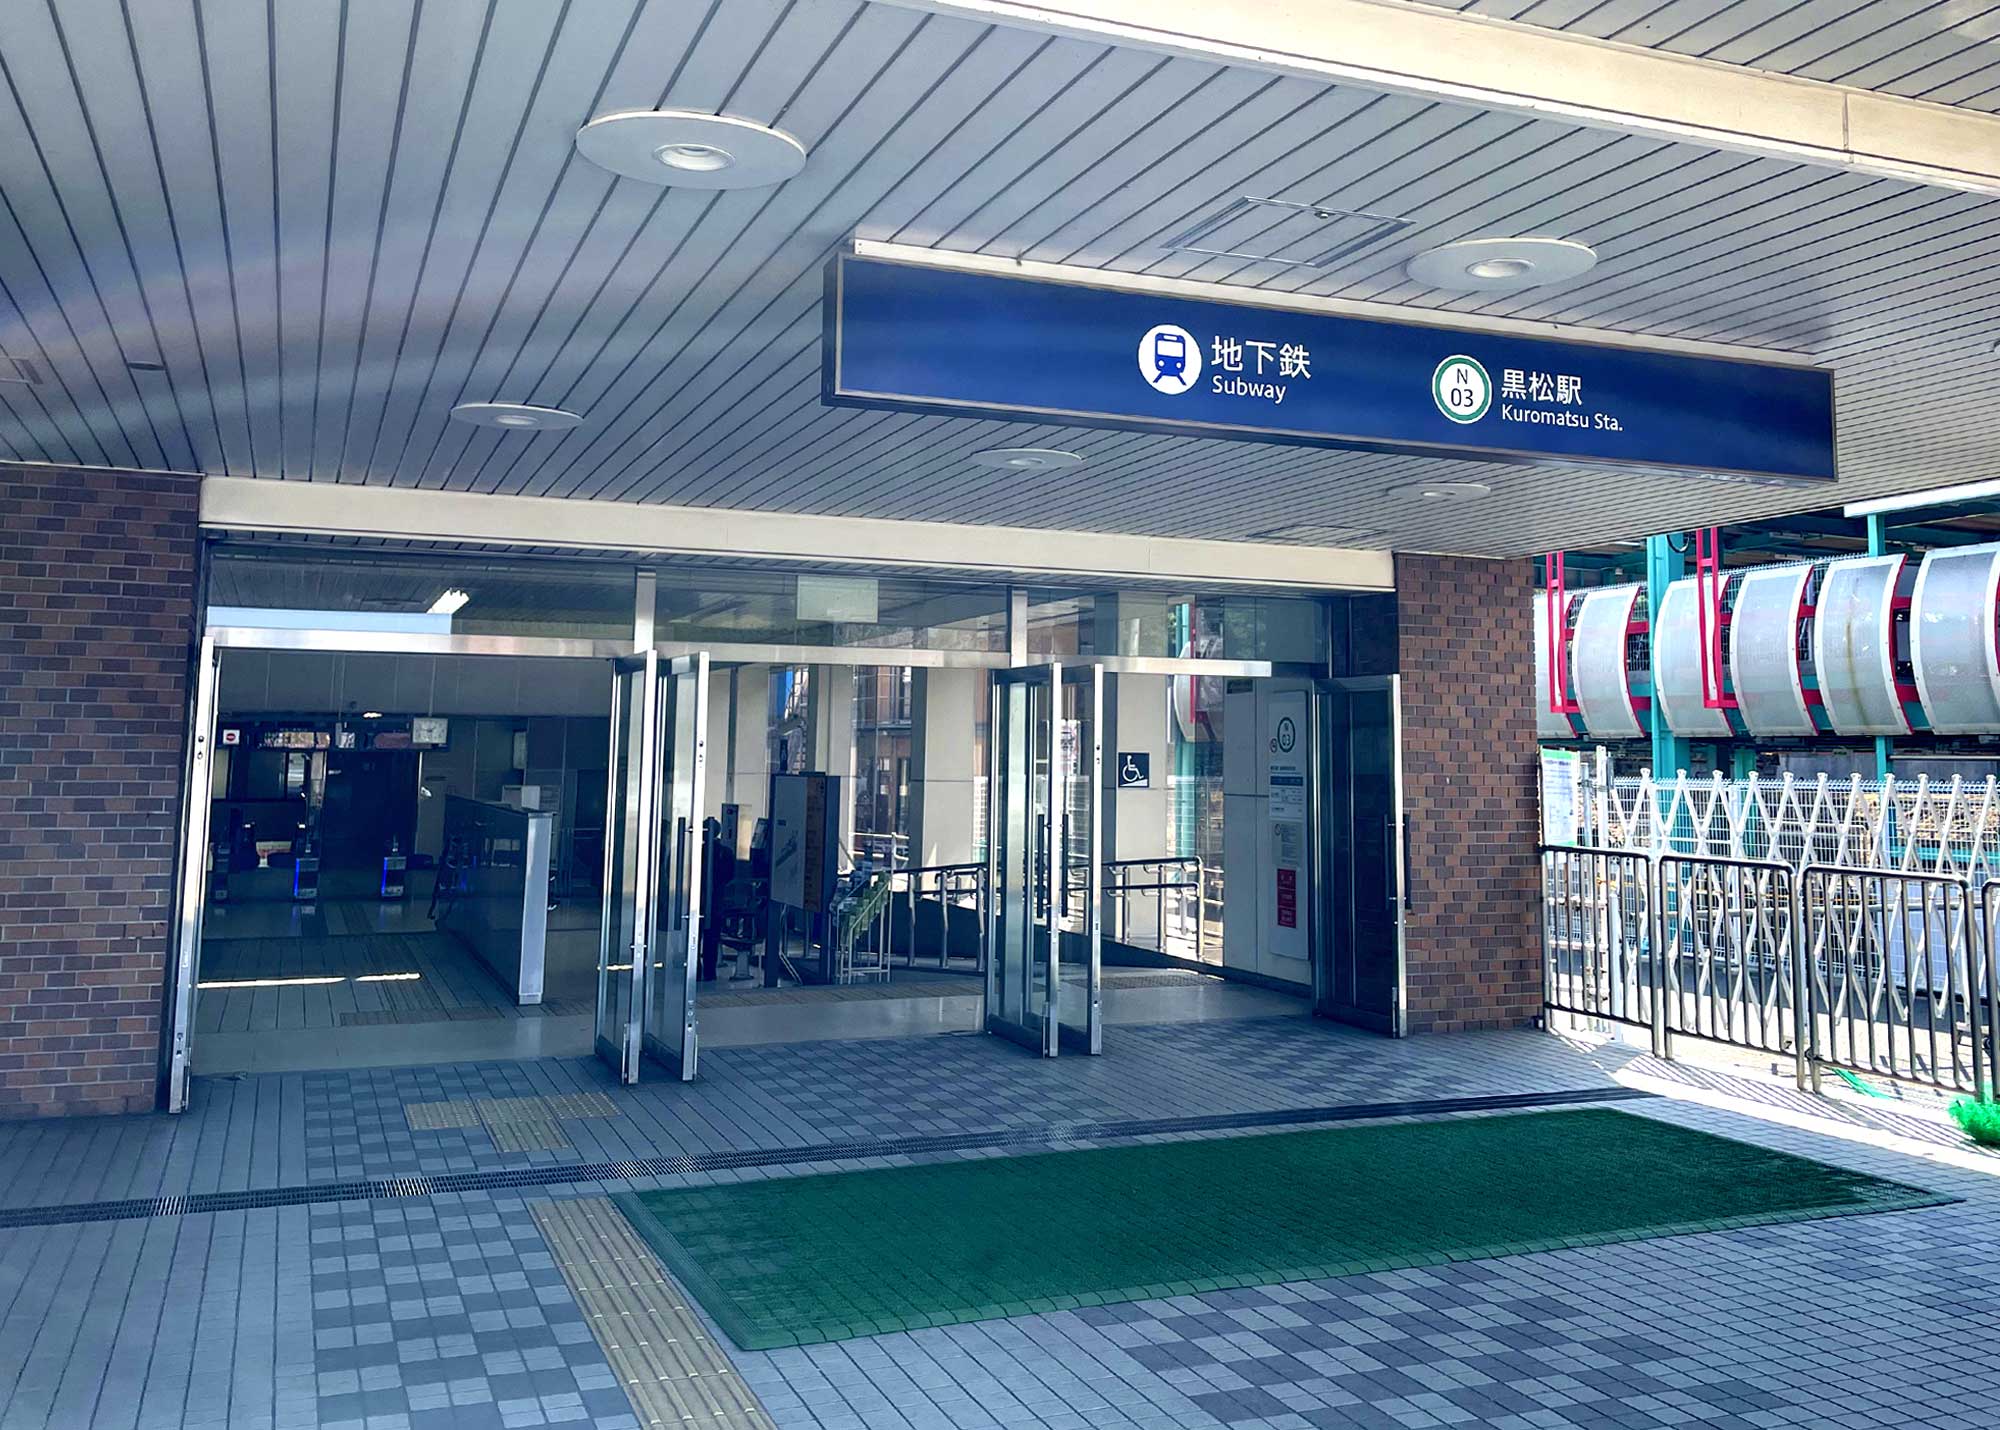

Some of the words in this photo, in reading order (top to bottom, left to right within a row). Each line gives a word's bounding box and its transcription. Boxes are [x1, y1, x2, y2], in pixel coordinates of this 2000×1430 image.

[1211, 335, 1311, 379] 地下鉄
[1212, 375, 1286, 404] Subway
[1457, 368, 1468, 385] N
[1501, 368, 1583, 406] 黒松駅
[1451, 388, 1474, 408] 03
[1502, 403, 1589, 429] Kuromatsu
[1594, 413, 1624, 432] Sta.
[1281, 733, 1291, 747] 03
